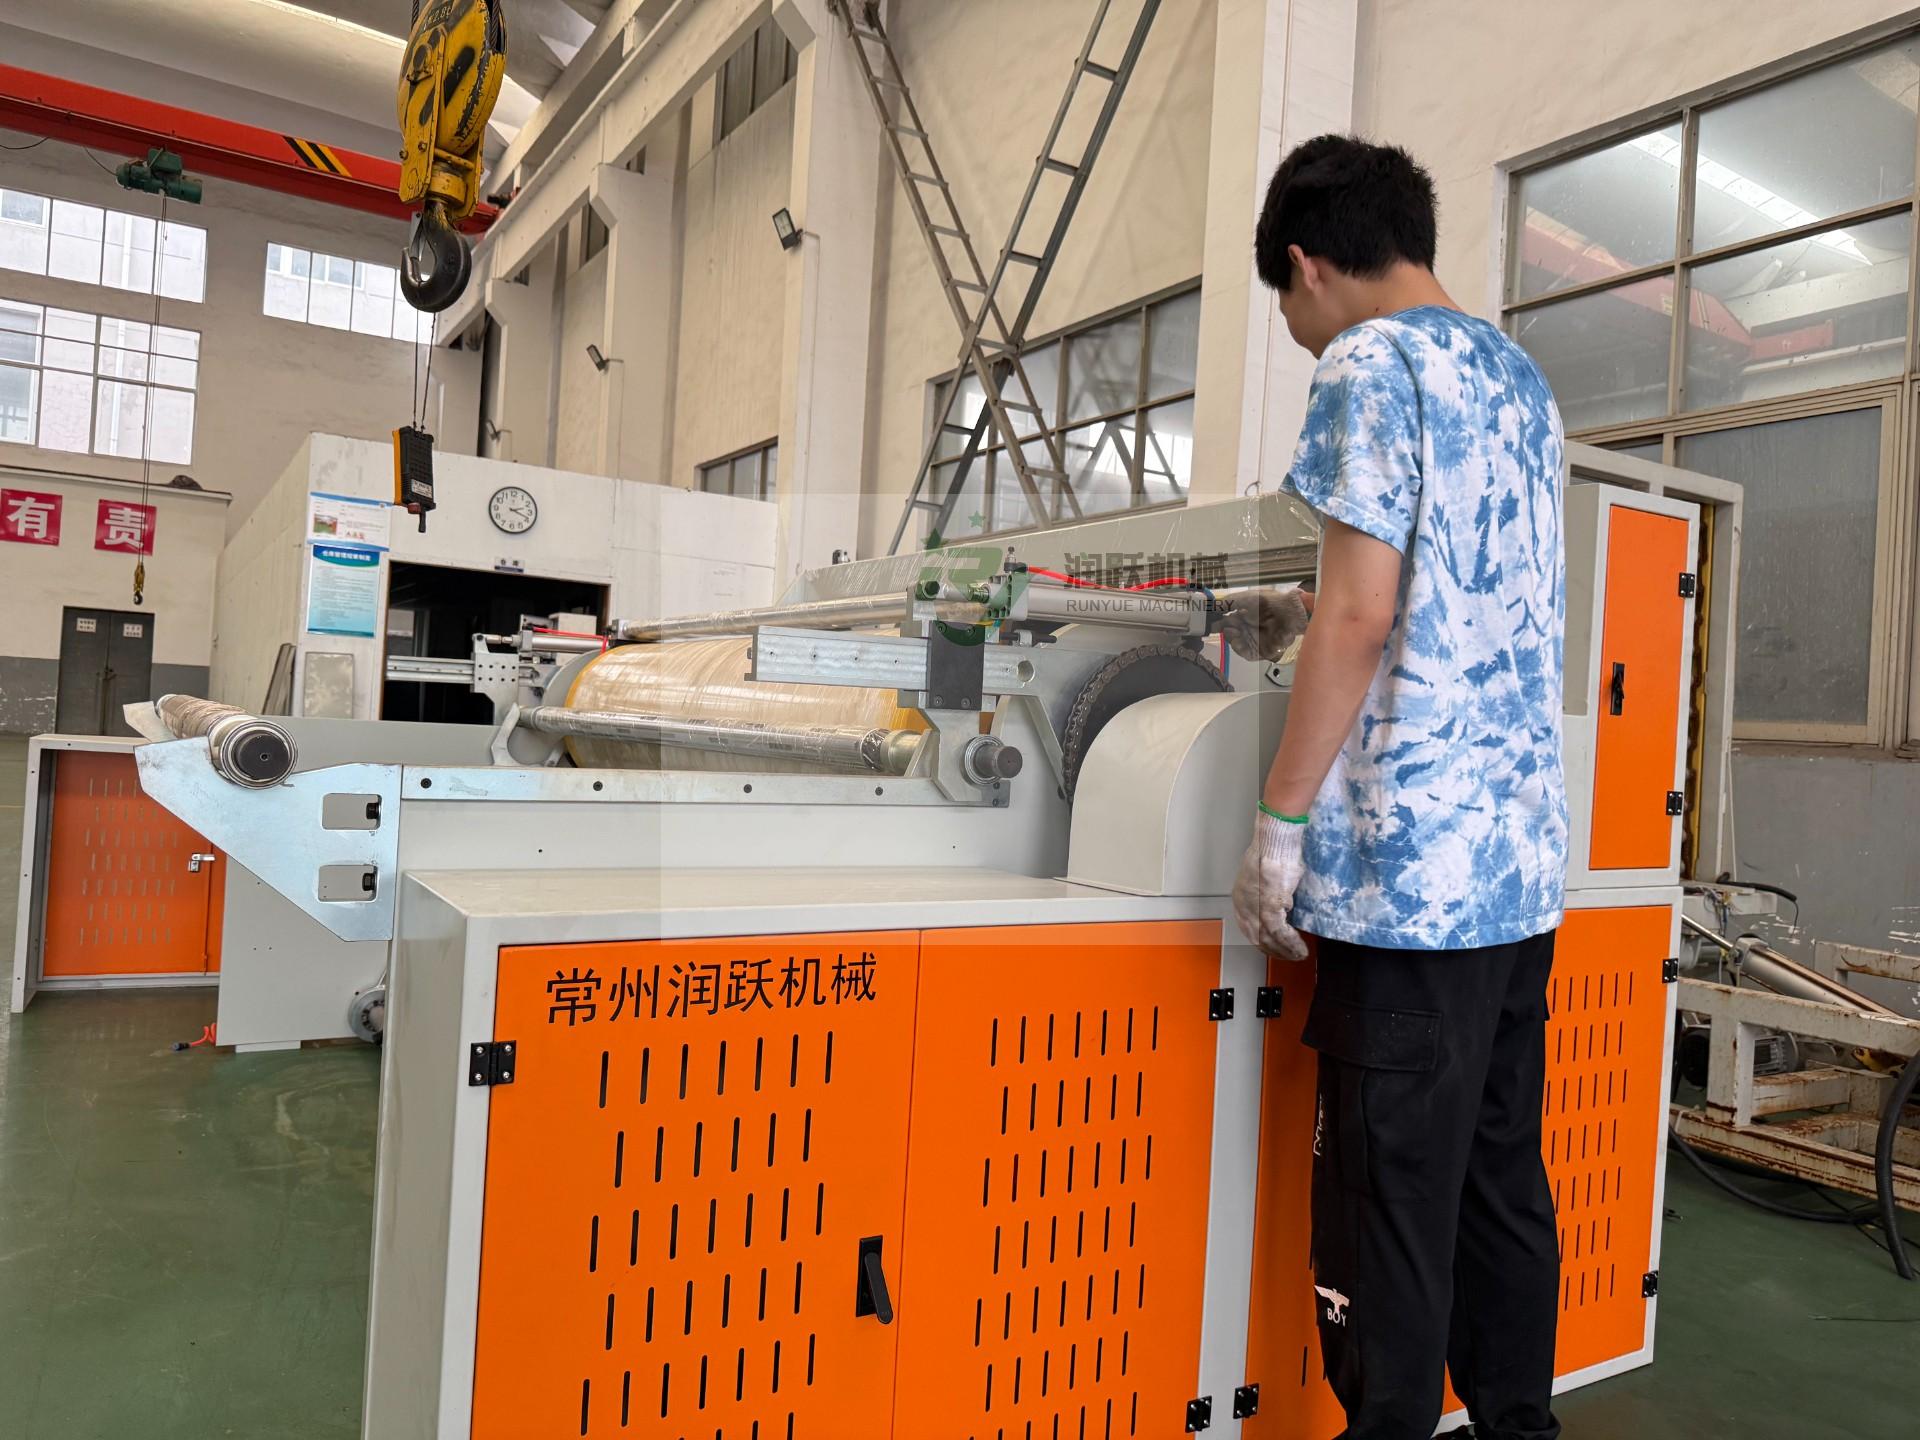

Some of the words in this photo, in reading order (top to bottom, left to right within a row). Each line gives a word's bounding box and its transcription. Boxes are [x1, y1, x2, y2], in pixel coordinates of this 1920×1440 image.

[525, 500, 531, 508] 2
[7, 497, 55, 539] 有
[104, 507, 147, 549] 责
[546, 951, 877, 1027] 常州润跃机械
[1327, 1307, 1347, 1327] BOY
